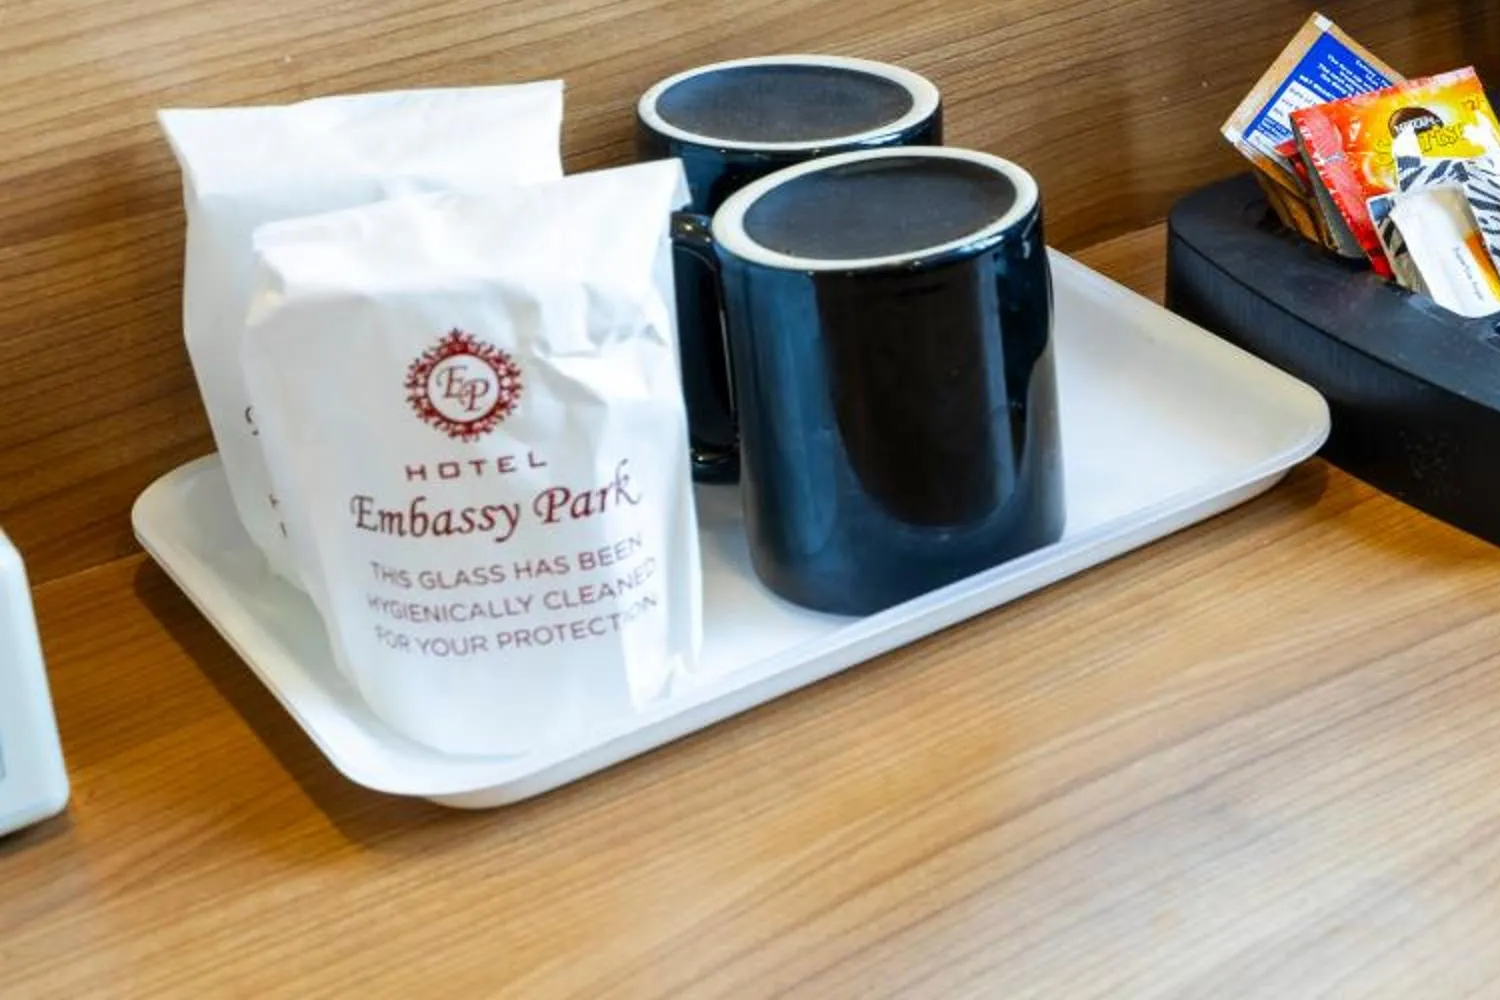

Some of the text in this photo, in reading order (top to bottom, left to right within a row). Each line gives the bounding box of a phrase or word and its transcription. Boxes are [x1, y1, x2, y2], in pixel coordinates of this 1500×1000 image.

[405, 452, 547, 481] HOTEL
[351, 458, 642, 543] Embassy Park
[366, 556, 658, 623] HYGIENICALLY CLEANED
[369, 535, 643, 590] THIS GLASS HAS BEEN
[374, 624, 411, 648] FOR
[413, 635, 489, 657] YOUR
